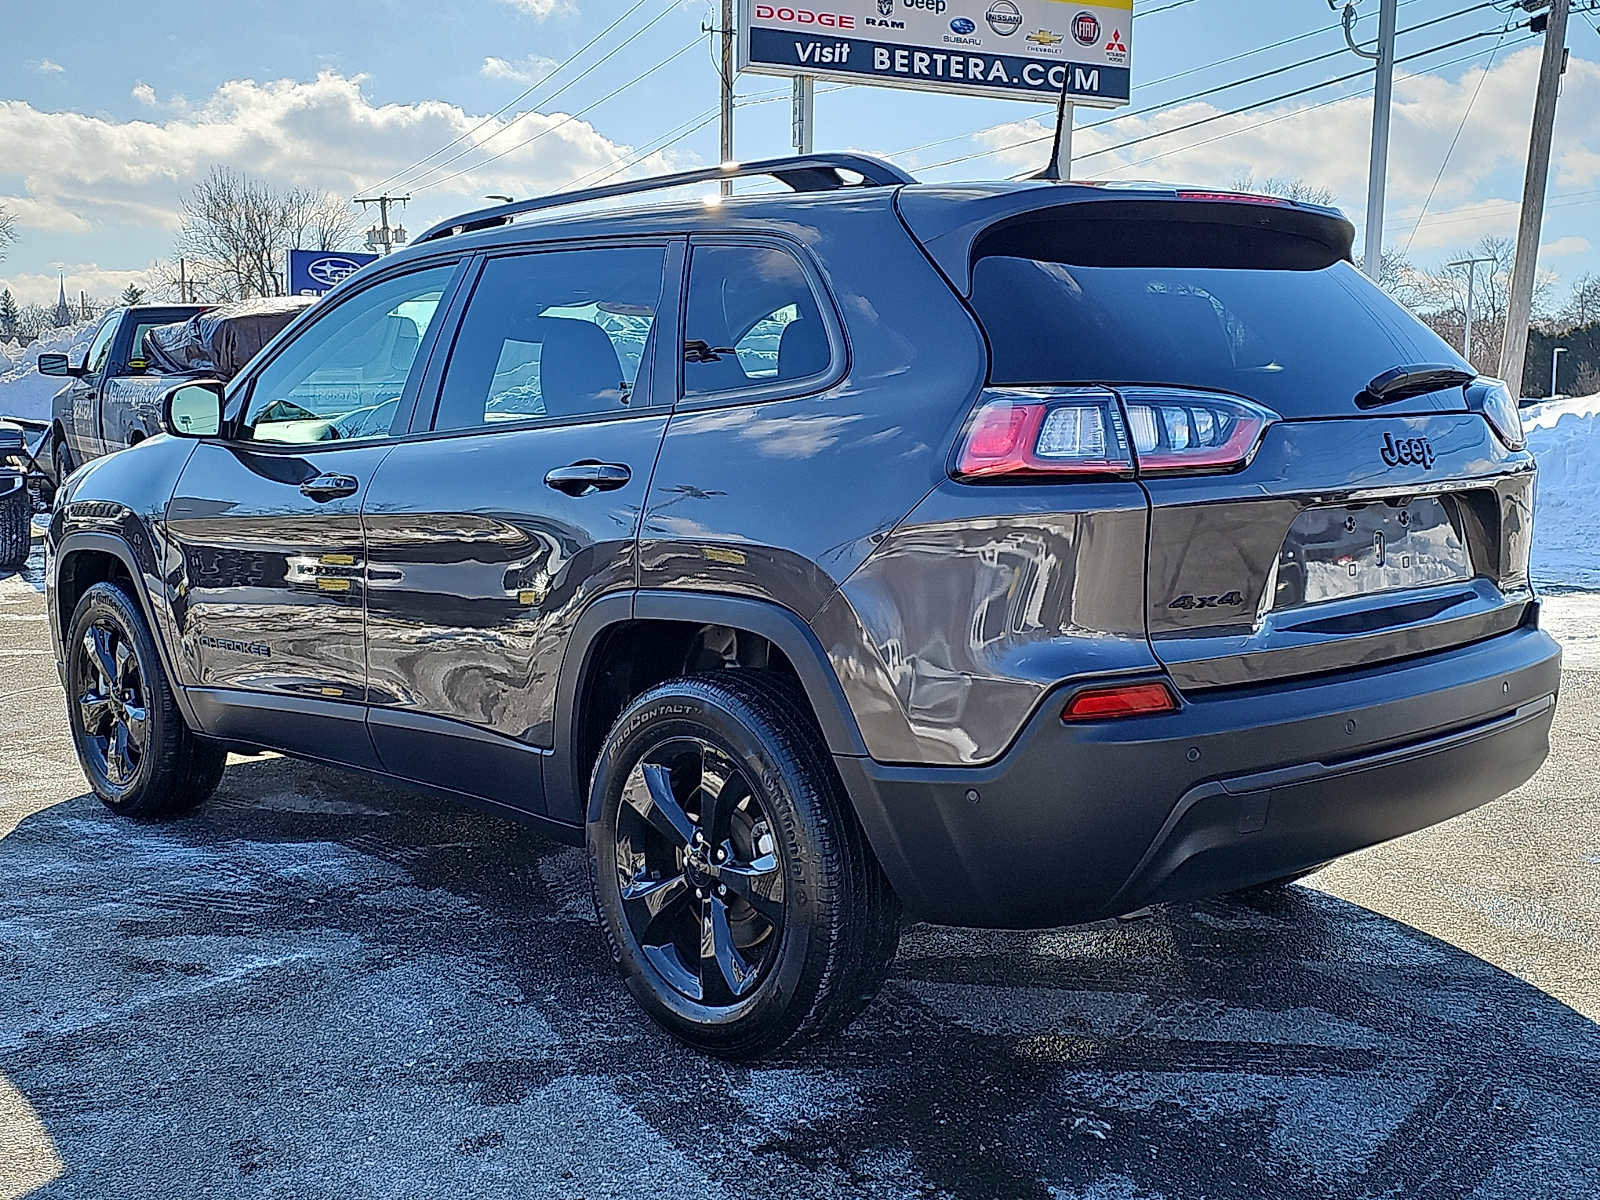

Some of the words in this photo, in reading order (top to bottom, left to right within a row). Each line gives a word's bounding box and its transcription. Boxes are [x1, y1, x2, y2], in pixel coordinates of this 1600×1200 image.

[756, 5, 855, 29] DODGE
[865, 17, 905, 30] RAM
[988, 13, 1020, 23] NISSAN
[1078, 21, 1096, 38] FIAT
[943, 35, 982, 46] SUBARU
[1026, 45, 1063, 55] CHEVROLET
[795, 42, 851, 64] Visit
[873, 47, 1099, 91] BERTERA.COM
[1380, 432, 1436, 471] Jeep
[1168, 591, 1244, 610] 4x4
[200, 636, 272, 658] CHEROKEE
